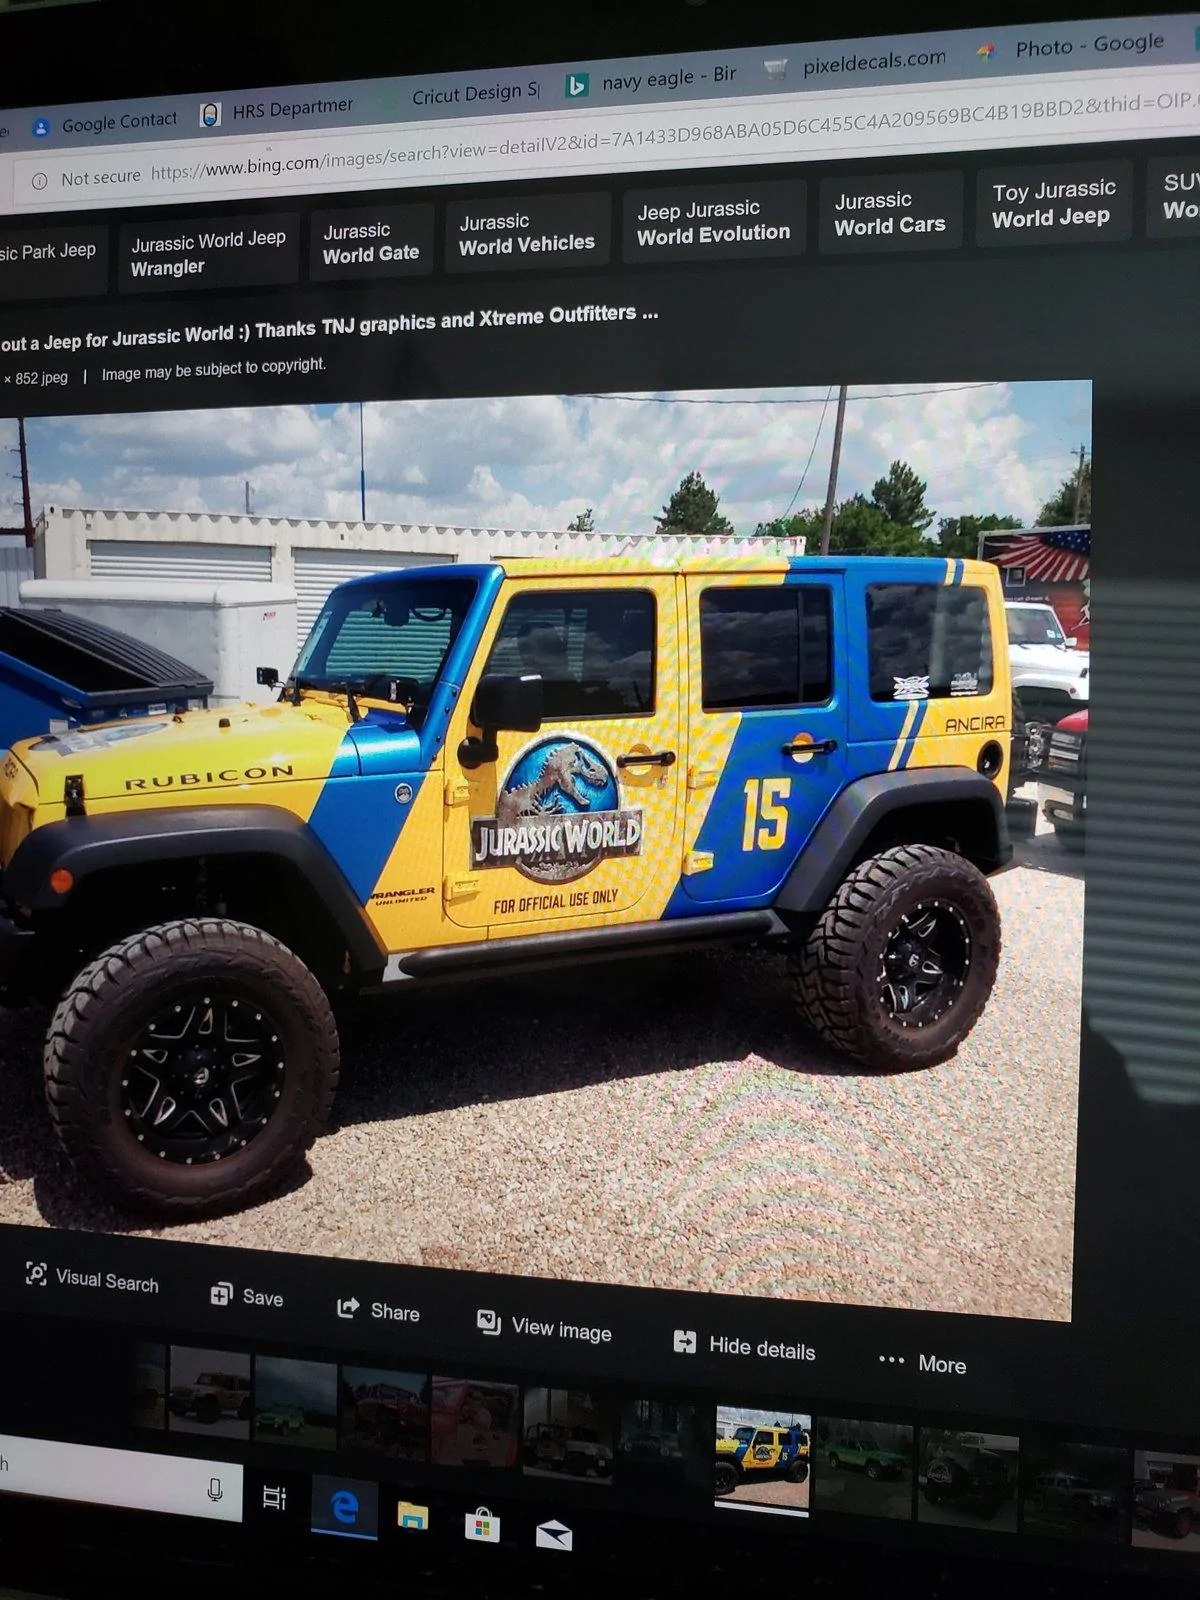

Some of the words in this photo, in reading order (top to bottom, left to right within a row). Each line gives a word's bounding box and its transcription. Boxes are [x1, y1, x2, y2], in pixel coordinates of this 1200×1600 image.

[1016, 39, 1073, 58] Photo
[1094, 33, 1164, 54] Google
[804, 50, 946, 76] pixeldecals.com
[603, 76, 642, 92] navy
[647, 68, 694, 90] eagle
[412, 88, 460, 105] Cricut
[465, 84, 522, 102] Design
[62, 115, 116, 134] Google
[120, 111, 177, 128] Contact
[233, 104, 265, 120] HRS
[62, 172, 90, 186] Not
[95, 168, 141, 184] secure
[835, 190, 912, 210] Jurassic
[993, 184, 1030, 204] Toy
[1034, 178, 1117, 199] Jurassic
[637, 204, 681, 223] Jeep
[686, 200, 761, 219] Jurassic
[992, 209, 1054, 229] World
[1060, 207, 1111, 228] Jeep
[1163, 200, 1199, 220] Wo
[323, 222, 391, 241] Jurassic
[460, 212, 530, 232] Jurassic
[834, 217, 893, 236] World
[899, 215, 947, 233] Cars
[132, 235, 194, 254] Jurassic
[199, 232, 244, 249] World
[248, 230, 287, 248] Jeep
[459, 238, 512, 256] World
[517, 233, 596, 253] Vehicles
[637, 228, 693, 246] World
[699, 224, 791, 243] Evolution
[22, 243, 56, 260] Park
[60, 242, 97, 259] Jeep
[322, 246, 374, 265] World
[379, 244, 420, 262] Gate
[131, 258, 206, 278] Wrangler
[1, 336, 27, 352] out
[30, 339, 40, 350] a
[44, 334, 82, 352] Jeep
[86, 332, 108, 348] for
[112, 328, 181, 346] Jurassic
[185, 325, 234, 343] World
[239, 324, 251, 342] :)
[255, 320, 317, 339] Thanks
[322, 318, 355, 335] TNJ
[359, 313, 437, 336] graphics
[441, 311, 475, 329] and
[479, 309, 545, 327] Xtreme
[549, 304, 637, 323] Outfitters
[15, 371, 39, 385] 852
[40, 372, 69, 387] jpeg
[102, 368, 141, 383] Image
[145, 367, 172, 381] may
[175, 364, 192, 377] be
[195, 361, 243, 379] subject
[246, 361, 259, 374] to
[261, 356, 327, 375] copyright.
[946, 715, 1006, 732] ANCIRA
[125, 765, 294, 790] RUBICON
[743, 777, 792, 851] 15
[475, 822, 561, 862] JURASSIC
[563, 817, 641, 855] WORLD
[370, 886, 436, 899] WRANGLER
[375, 896, 428, 907] UNLIMITED
[493, 899, 515, 915] FOR
[518, 895, 565, 912] OFFICIAL
[569, 892, 590, 907] USE
[593, 888, 619, 904] ONLY
[56, 1267, 102, 1288] Visual
[105, 1273, 159, 1294] Search
[243, 1288, 284, 1308] Save
[371, 1302, 421, 1322] Share
[512, 1316, 554, 1336] View
[559, 1319, 612, 1345] image
[710, 1335, 752, 1355] Hide
[757, 1339, 816, 1361] details
[919, 1354, 967, 1375] More
